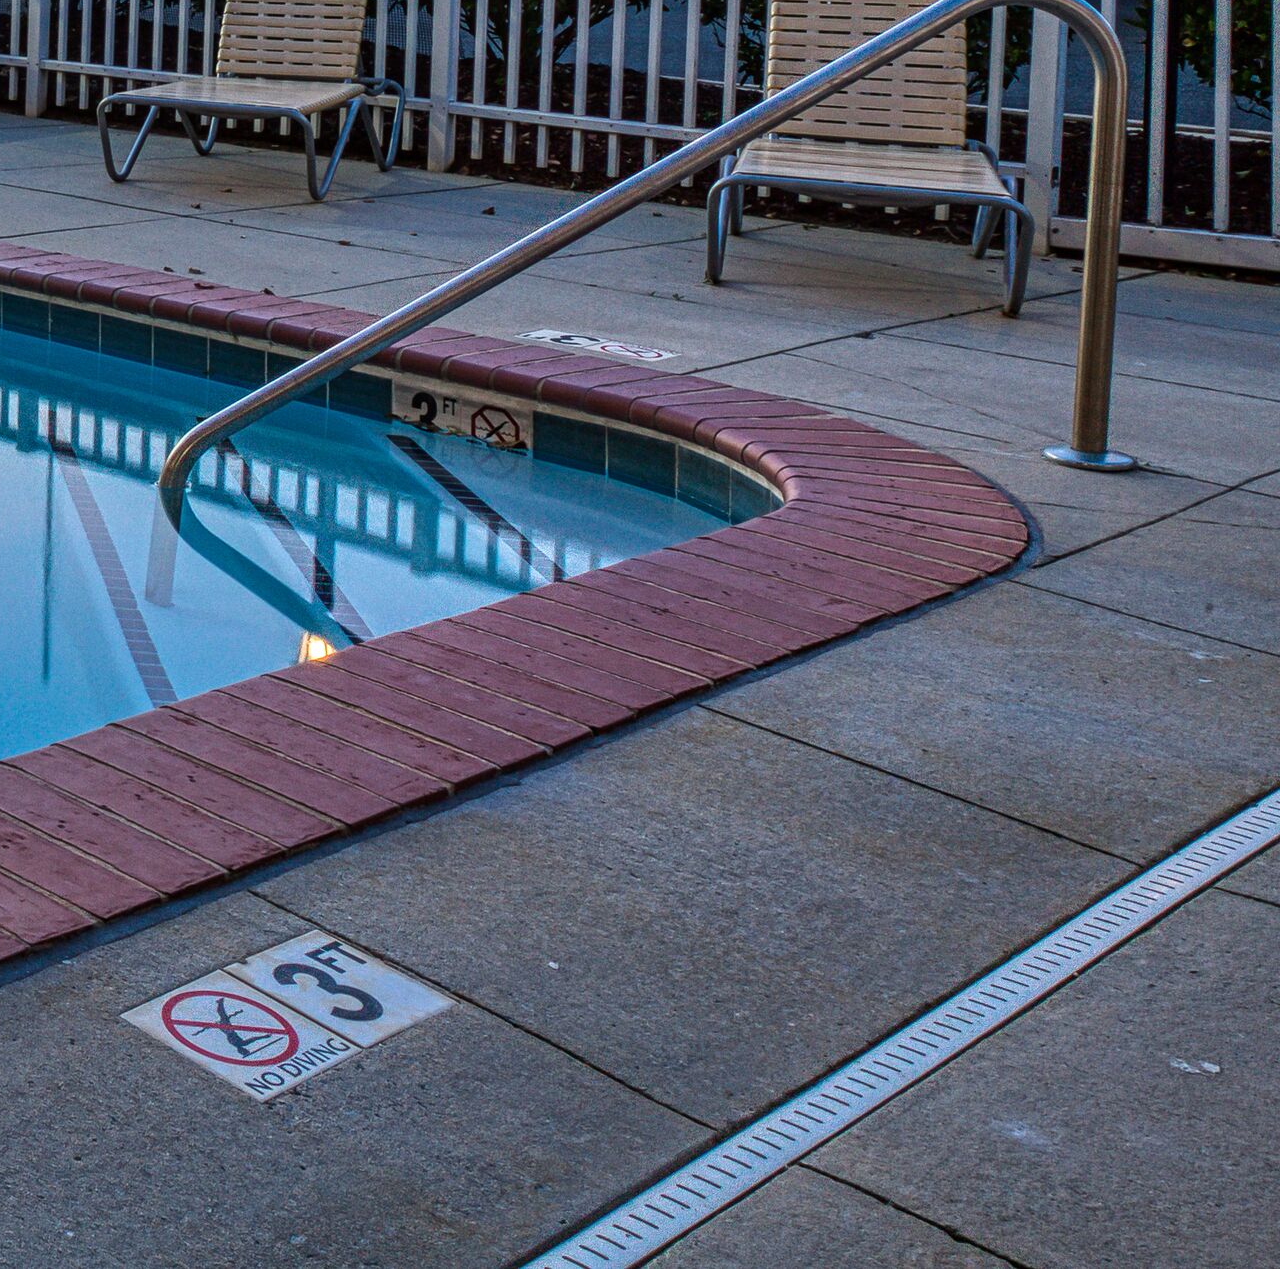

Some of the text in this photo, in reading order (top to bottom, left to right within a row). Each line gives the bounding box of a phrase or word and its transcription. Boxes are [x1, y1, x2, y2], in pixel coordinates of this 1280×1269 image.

[443, 397, 458, 416] FT
[272, 941, 384, 1022] 3 FT
[245, 1038, 350, 1096] NO DIVING
